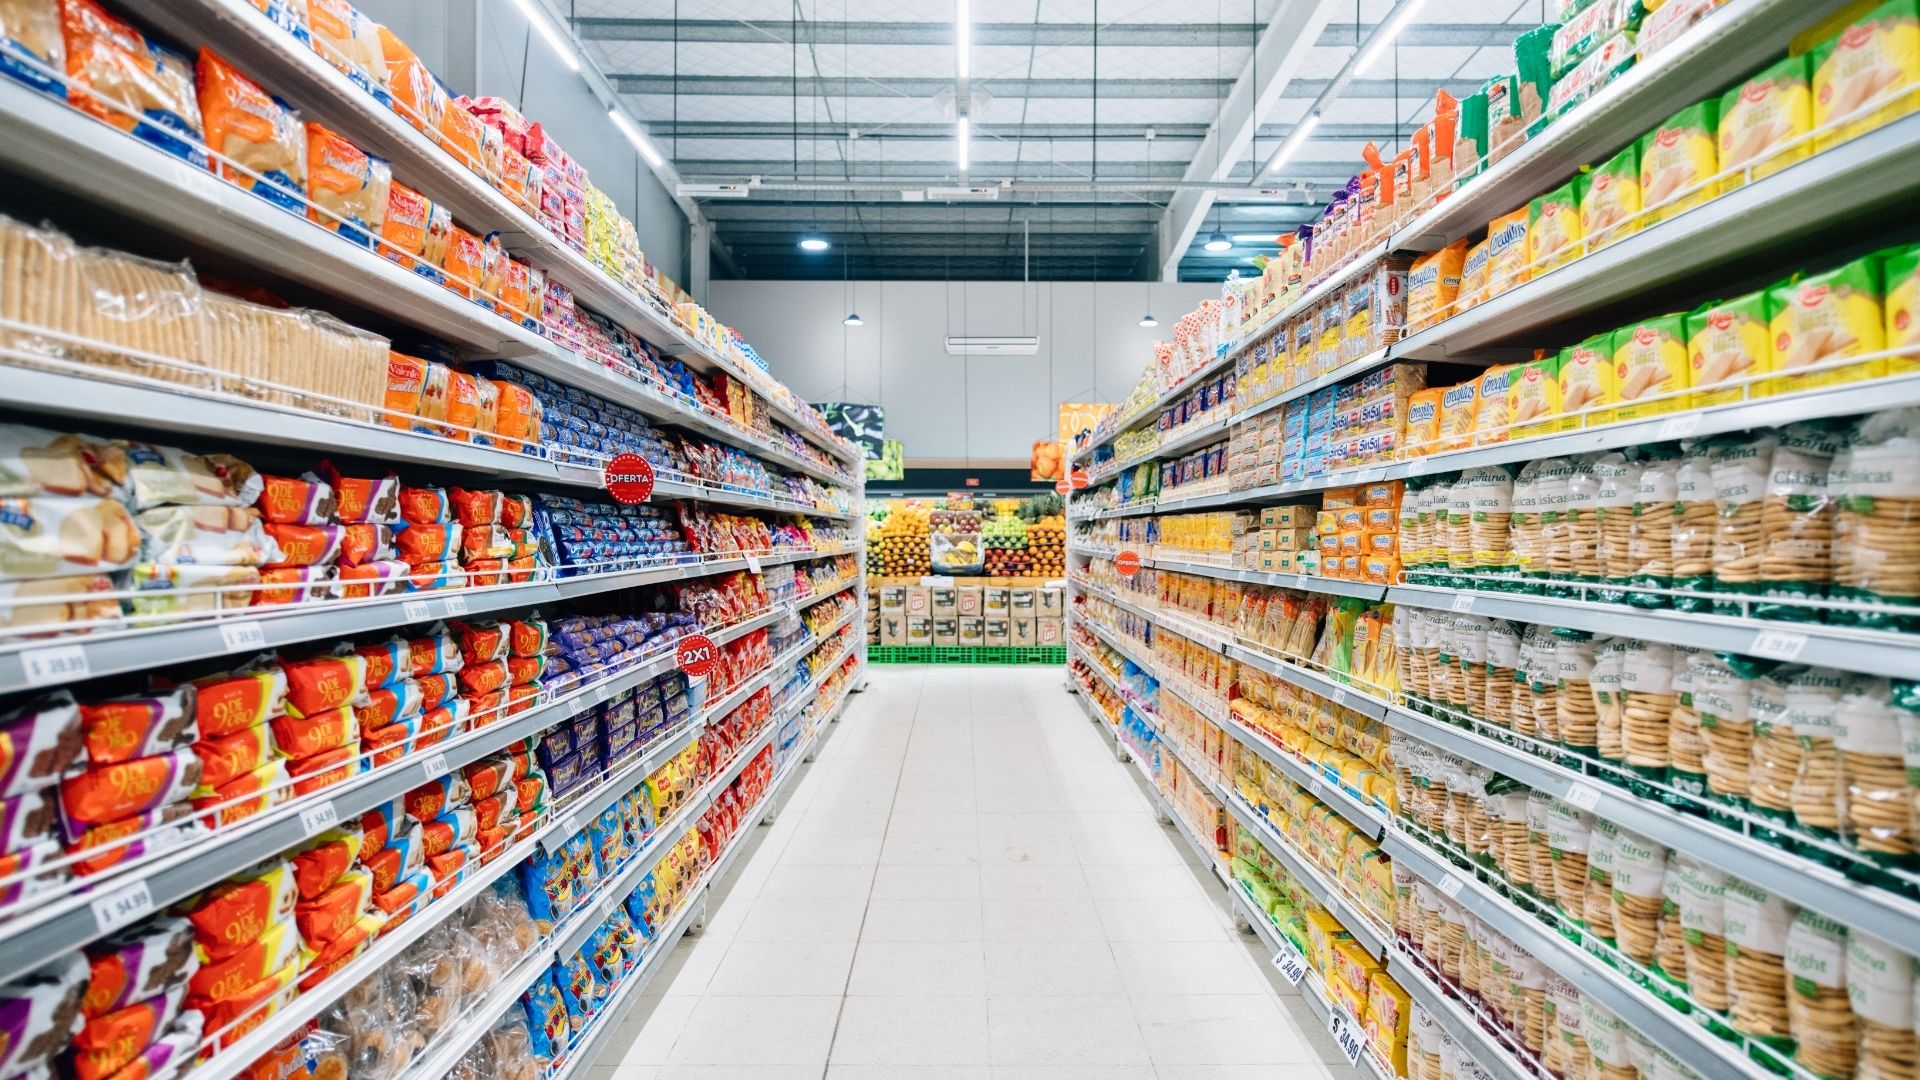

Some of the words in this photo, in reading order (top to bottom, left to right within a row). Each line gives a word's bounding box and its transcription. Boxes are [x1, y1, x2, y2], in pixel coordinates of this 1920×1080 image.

[1490, 221, 1525, 256] Cerealitas
[389, 362, 420, 379] Valente
[1481, 368, 1509, 398] Cerealit
[1443, 383, 1475, 408] Cerealitas
[1408, 402, 1435, 423] Cerealitas
[1359, 437, 1379, 452] SinSal
[610, 474, 649, 483] OFERTA
[520, 635, 529, 650] 9
[683, 646, 711, 664] 2X1
[317, 680, 329, 703] 9
[328, 677, 339, 691] DE
[327, 687, 347, 703] ORO
[213, 702, 228, 729] 9
[228, 697, 243, 711] DE
[226, 709, 254, 727] ORO
[308, 726, 321, 751] 9
[321, 722, 332, 736] DE
[426, 764, 432, 775] $
[110, 768, 128, 798] 9
[306, 817, 312, 830] $
[315, 808, 335, 825] 54.99
[1551, 831, 1568, 844] ght
[1596, 850, 1614, 864] ght
[102, 908, 111, 923] $
[115, 891, 148, 916] 54.99
[225, 921, 241, 944] 9
[241, 912, 256, 929] DE
[1725, 918, 1747, 936] ght
[1276, 953, 1286, 964] $
[1281, 960, 1303, 983] 34.99
[1787, 946, 1827, 974] Light
[210, 980, 226, 1002] 9
[1332, 1017, 1340, 1034] $
[1339, 1027, 1359, 1060] 34.99
